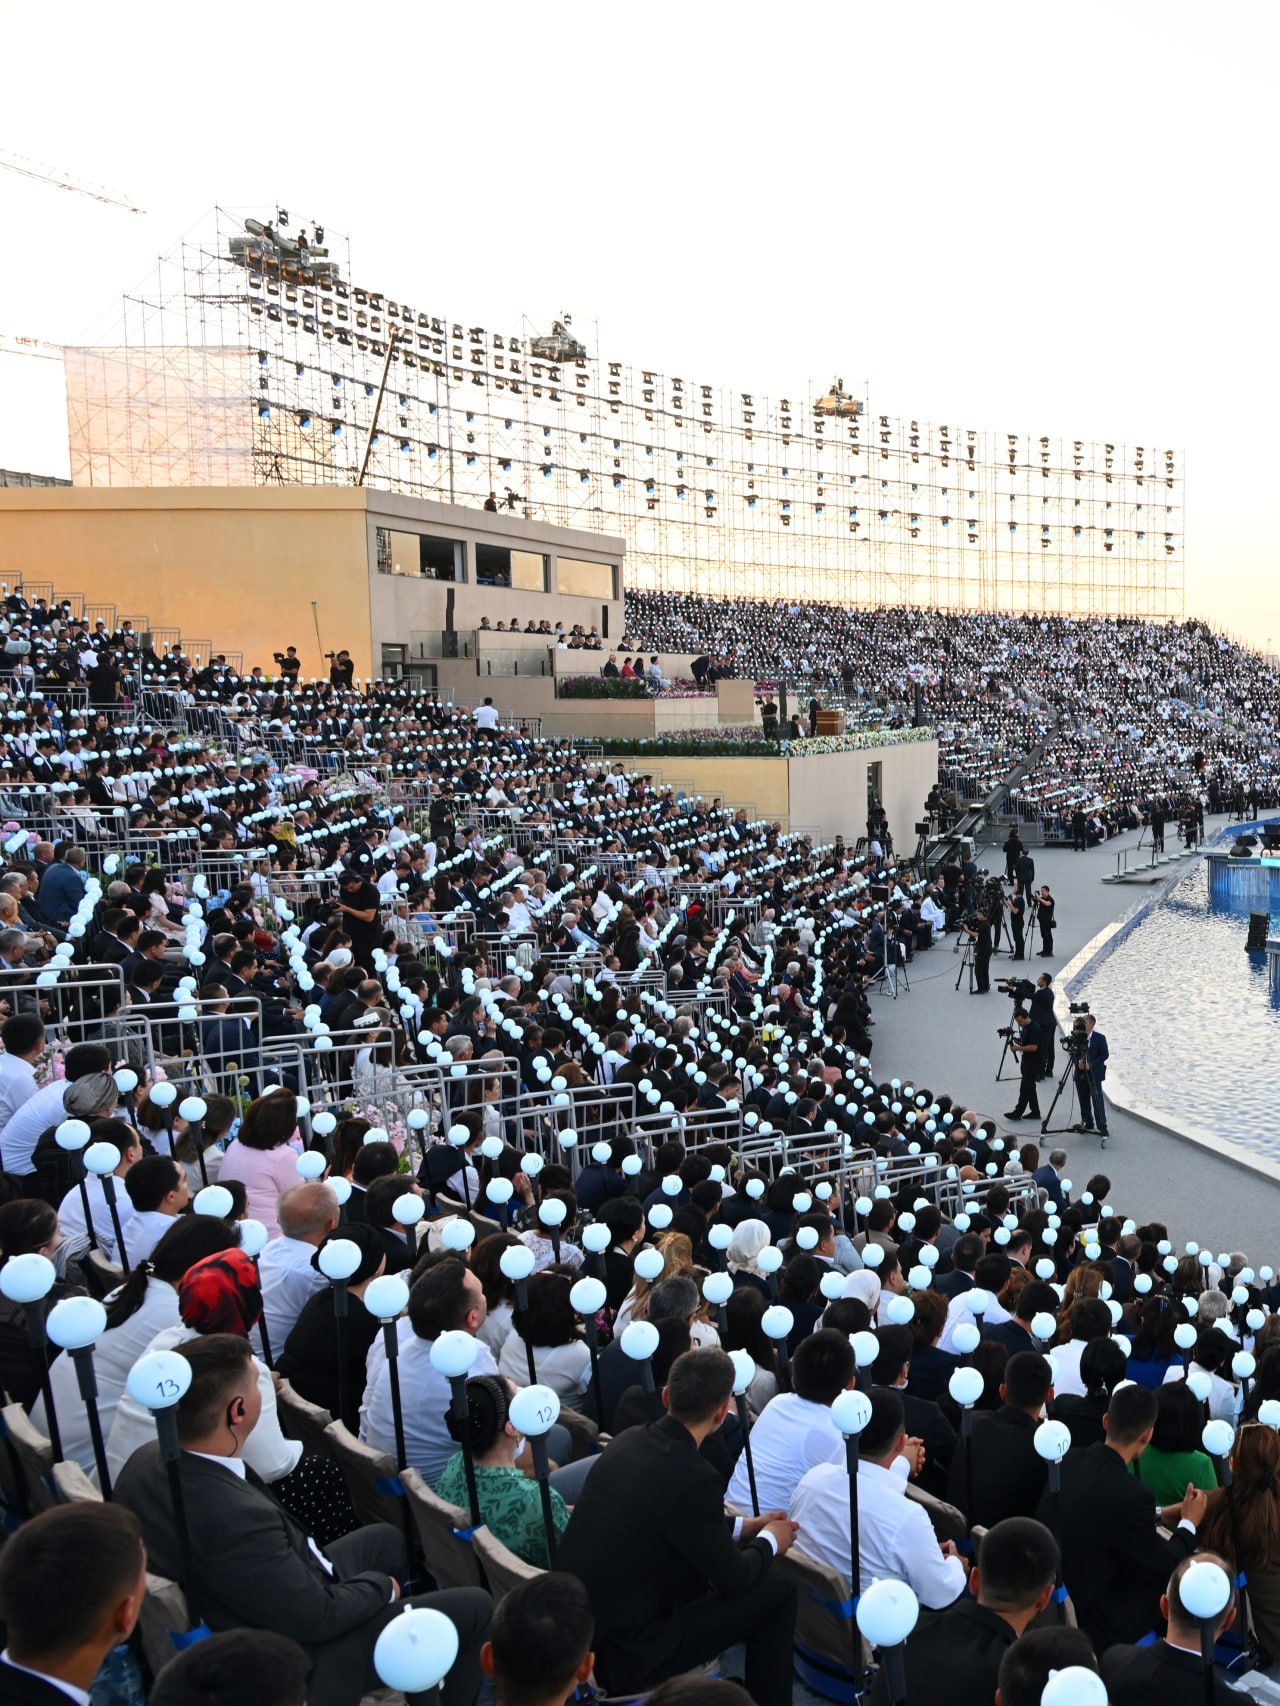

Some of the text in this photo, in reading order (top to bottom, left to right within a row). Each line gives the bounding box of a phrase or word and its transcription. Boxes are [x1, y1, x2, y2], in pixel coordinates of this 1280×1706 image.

[672, 1181, 680, 1191] 8
[156, 1379, 180, 1398] 13
[537, 1406, 556, 1424] 12
[857, 1410, 868, 1425] 11
[1057, 1439, 1070, 1455] 10
